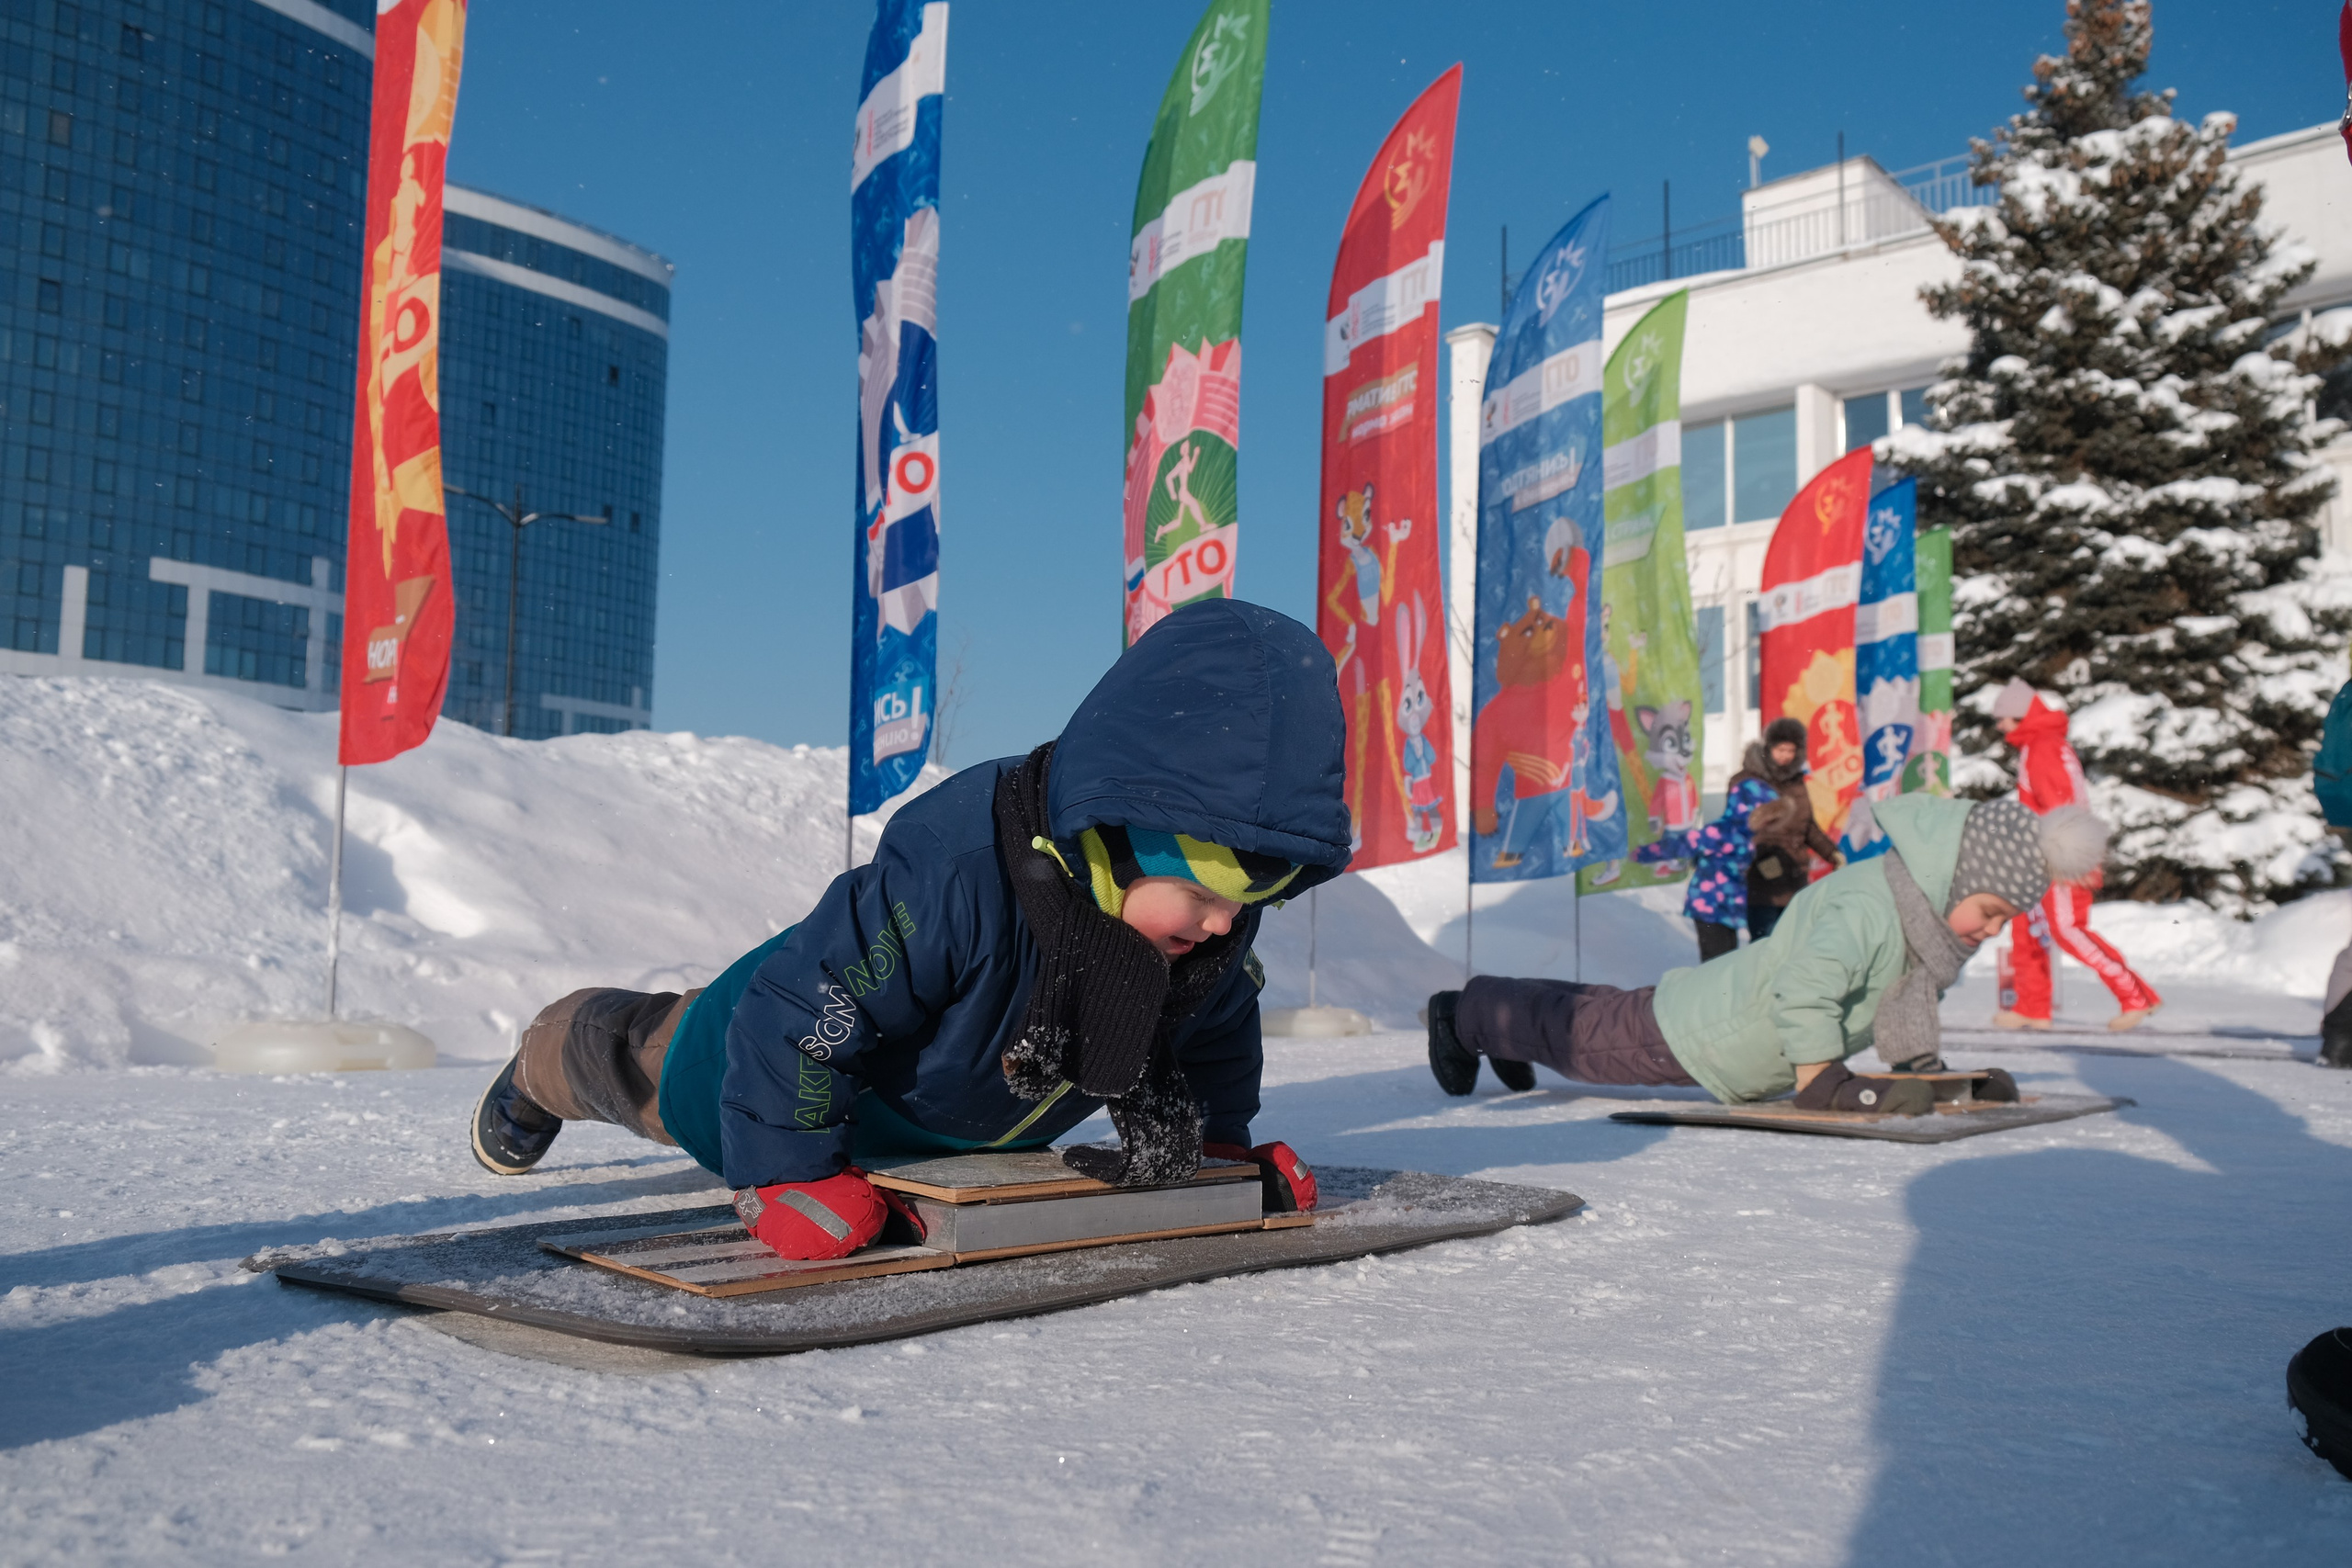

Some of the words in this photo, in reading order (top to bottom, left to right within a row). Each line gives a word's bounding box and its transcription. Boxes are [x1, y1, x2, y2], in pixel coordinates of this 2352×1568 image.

[1162, 538, 1227, 598] ГТО
[798, 972, 857, 1062] SOM
[795, 1053, 831, 1134] AKE
